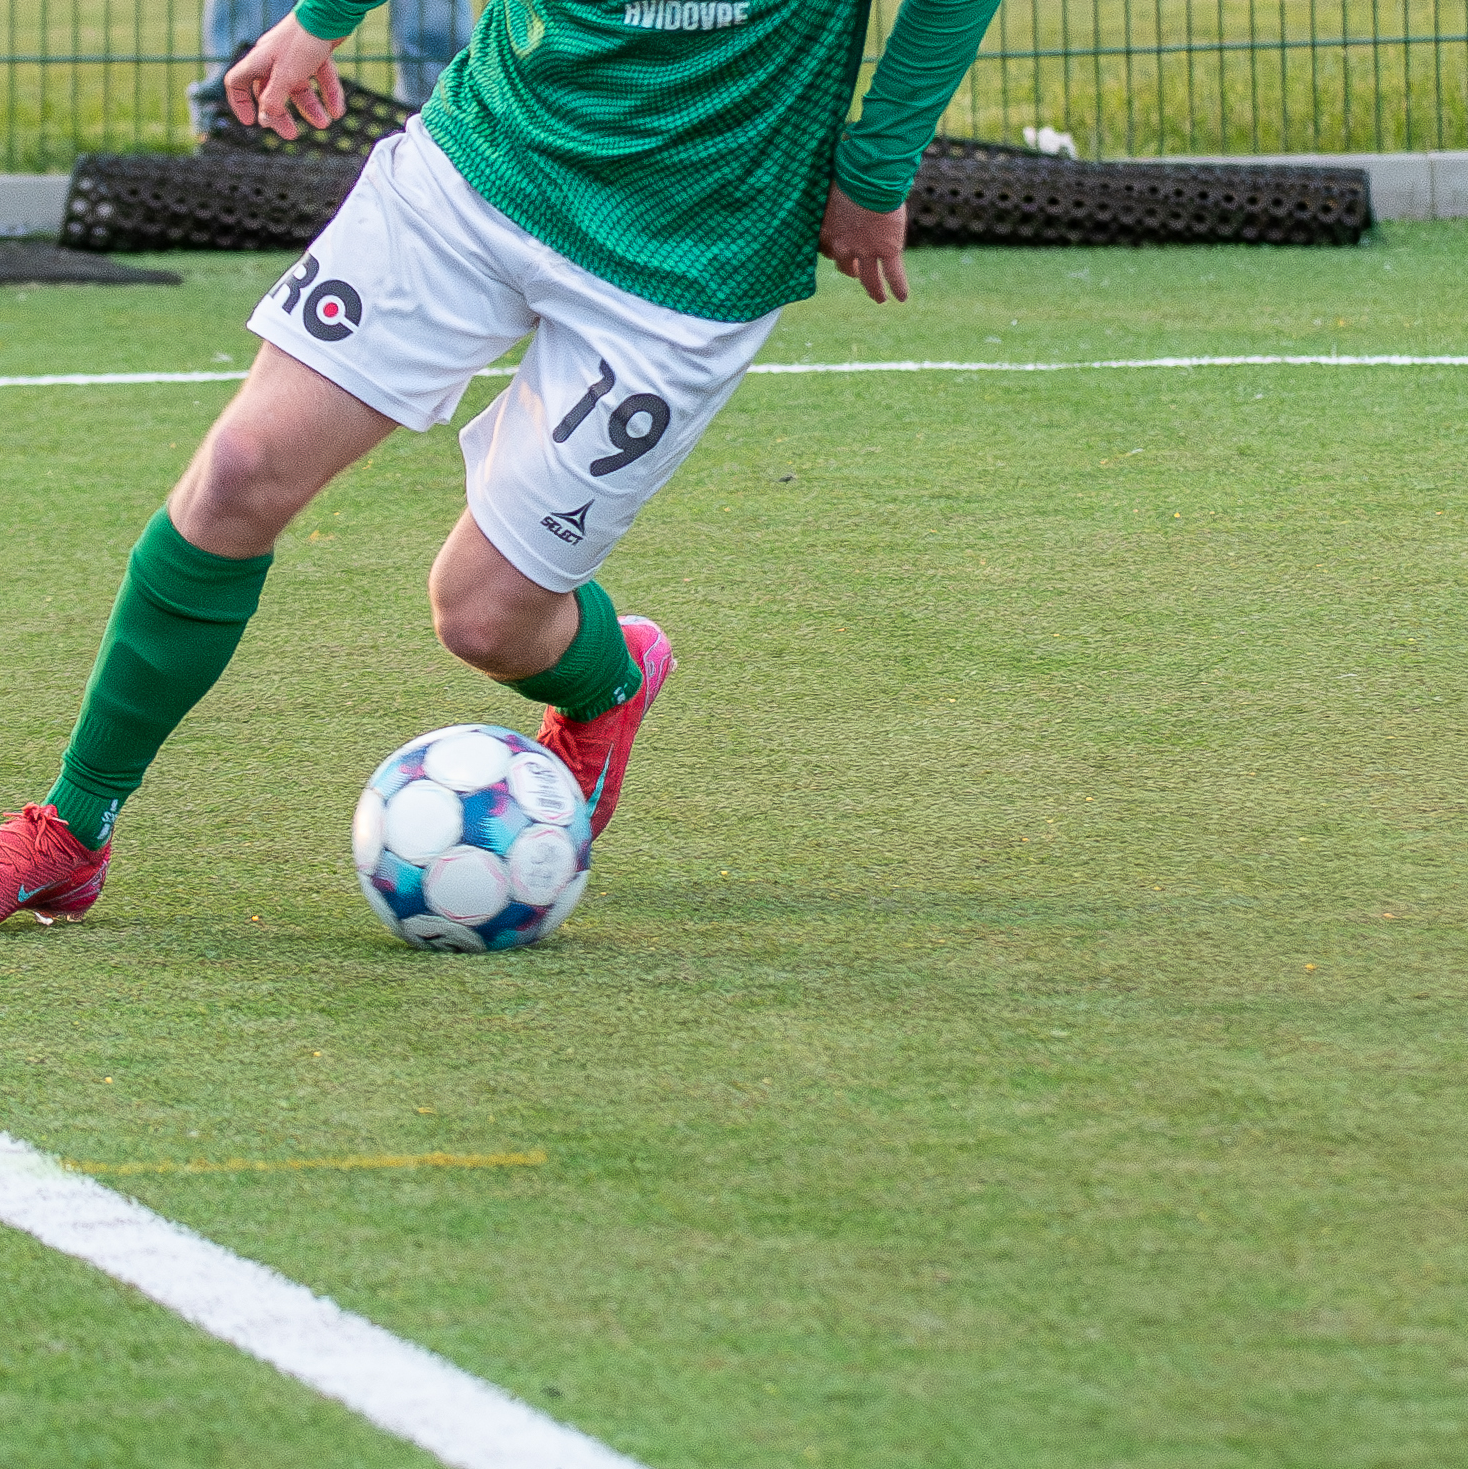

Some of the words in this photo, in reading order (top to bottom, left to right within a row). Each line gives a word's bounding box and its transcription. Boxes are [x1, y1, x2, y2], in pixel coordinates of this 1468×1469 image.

[624, 0, 751, 31] HVIDOVRE
[552, 357, 671, 478] 19
[540, 516, 584, 546] SELECT
